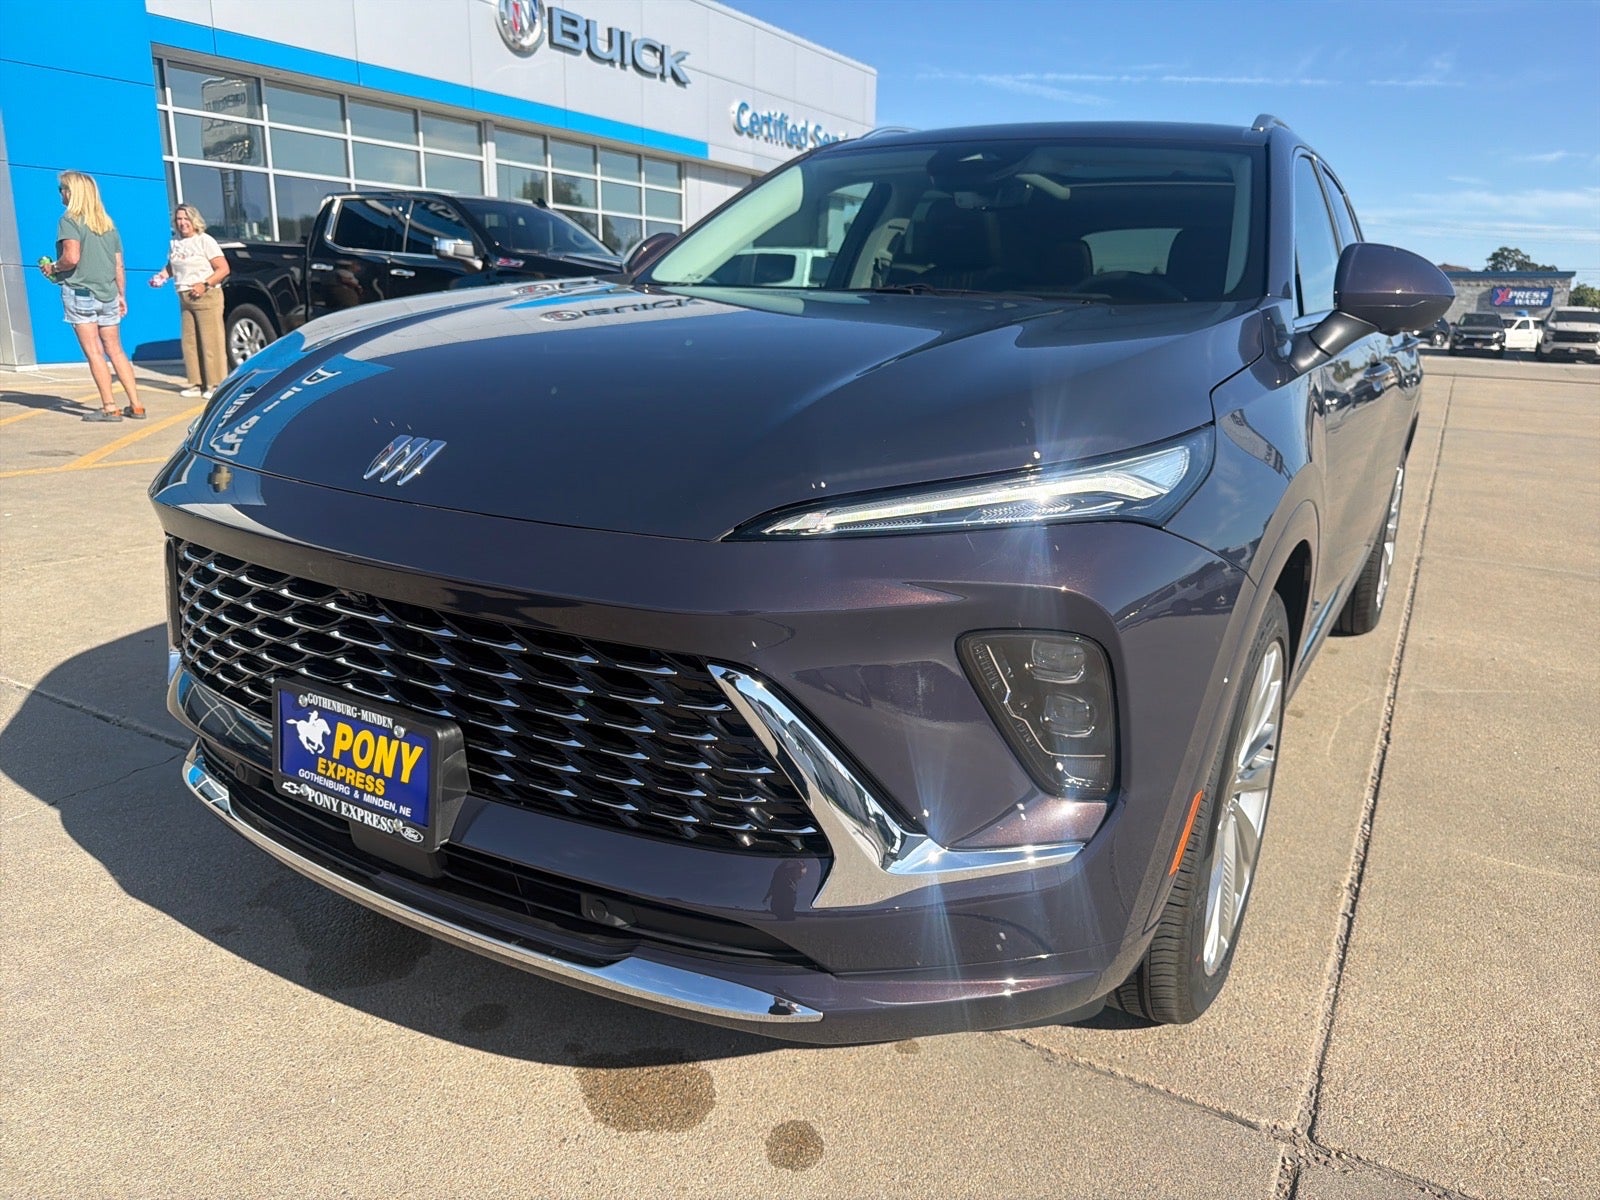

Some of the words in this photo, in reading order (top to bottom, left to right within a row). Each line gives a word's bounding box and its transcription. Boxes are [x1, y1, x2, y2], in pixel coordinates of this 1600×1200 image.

[549, 7, 691, 86] BUICK
[737, 102, 808, 148] Certified
[814, 125, 848, 147] Ser
[1495, 288, 1549, 305] XPRESS
[307, 693, 393, 729] GOTHENBURG-MINDEN
[332, 721, 424, 784] PONY
[298, 768, 350, 795] GOTHENBURG
[353, 789, 360, 799] &
[363, 792, 398, 814] MINDEN,
[399, 805, 412, 818] NE
[317, 756, 385, 796] EXPRESS
[308, 788, 340, 812] PONY
[341, 803, 394, 834] EXPRESS
